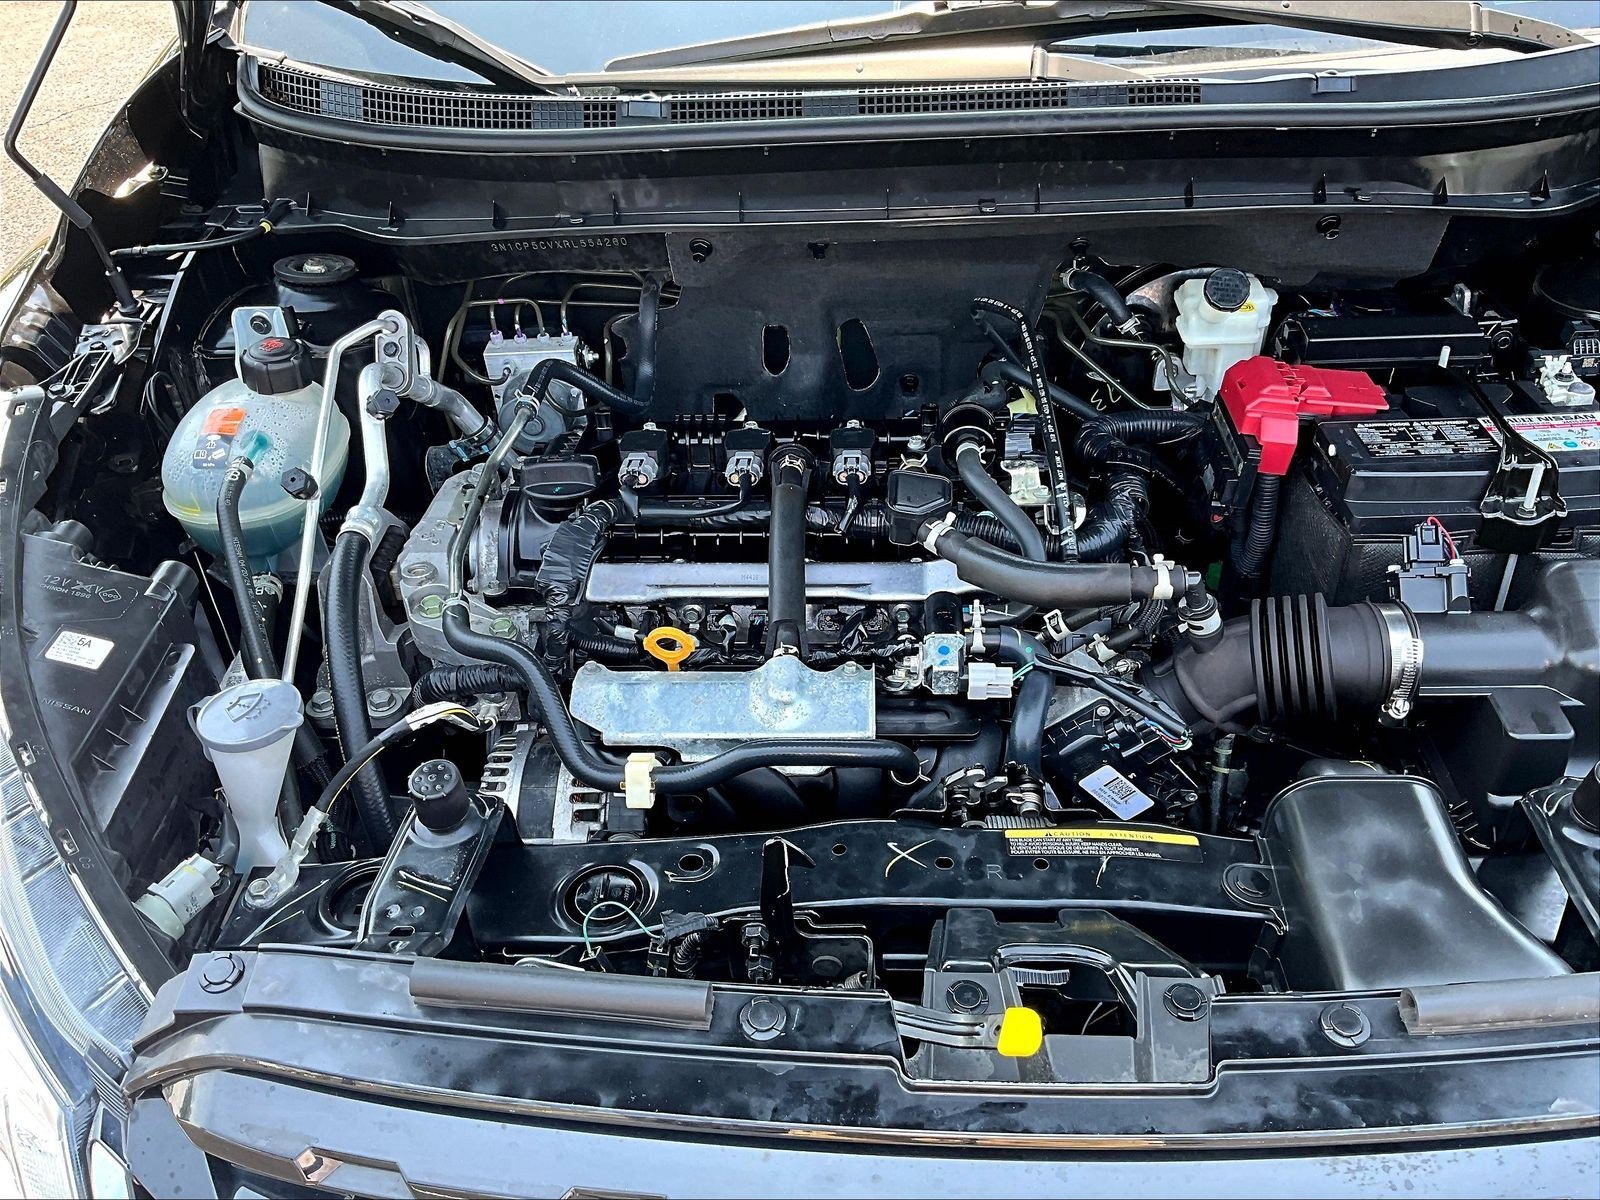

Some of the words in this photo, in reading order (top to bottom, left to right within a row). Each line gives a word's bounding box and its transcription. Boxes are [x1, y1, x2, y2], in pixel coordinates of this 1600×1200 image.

[1536, 413, 1596, 422] NISSAN
[232, 536, 244, 559] NISSAN
[42, 698, 91, 716] NISSAN
[1109, 832, 1154, 840] ATTENTION
